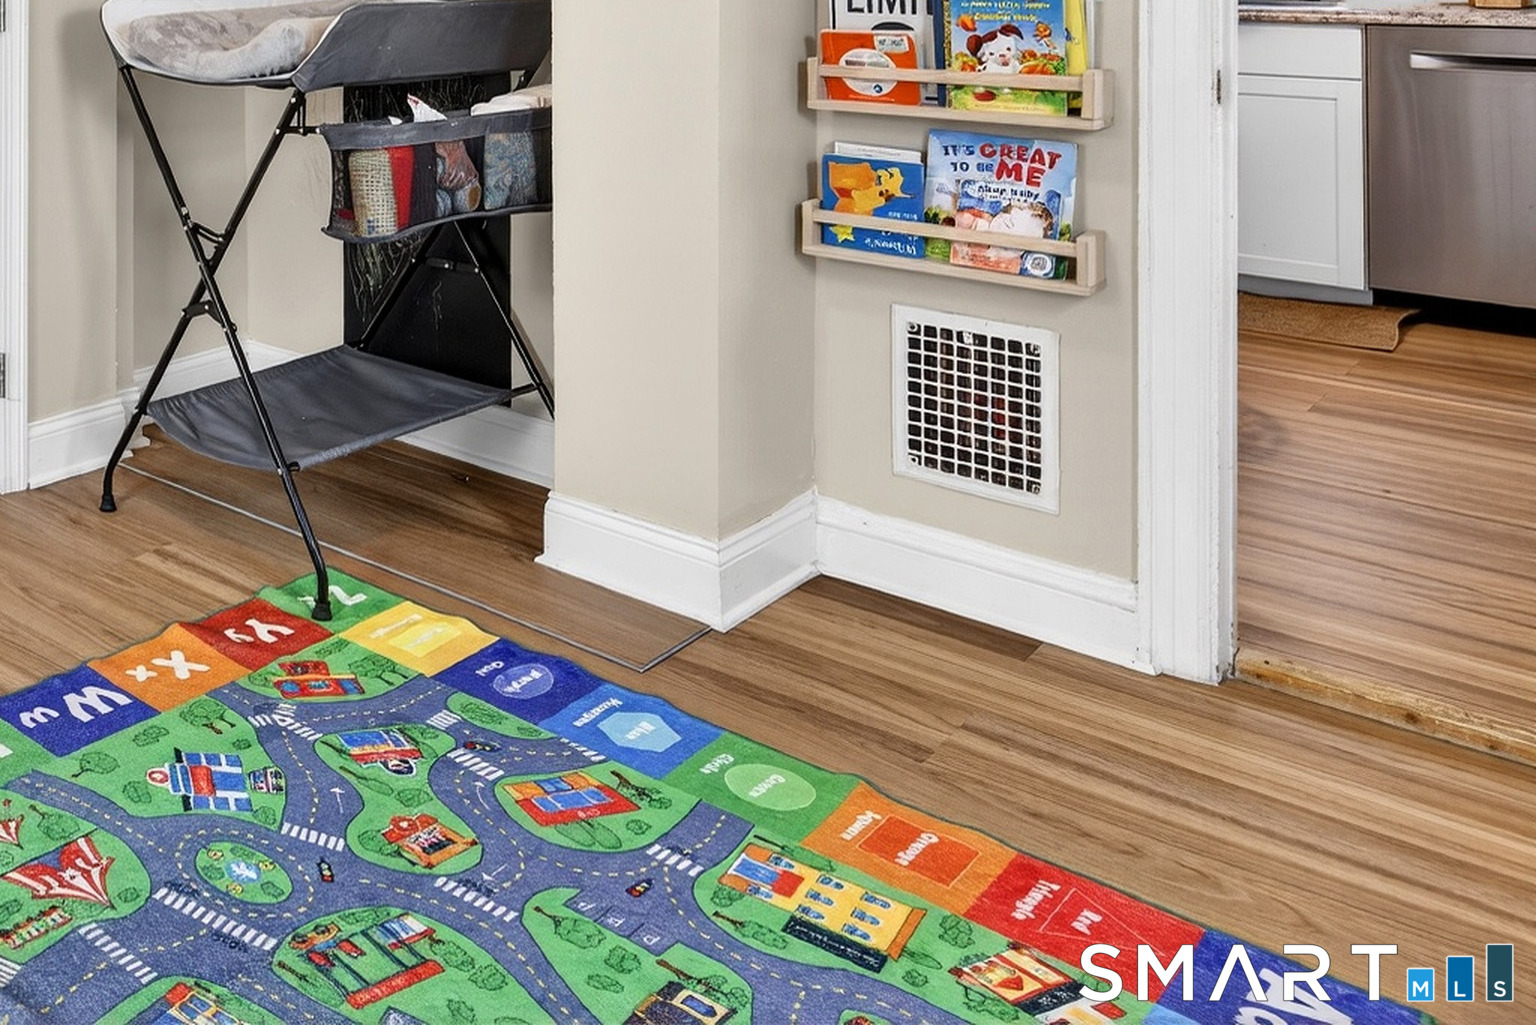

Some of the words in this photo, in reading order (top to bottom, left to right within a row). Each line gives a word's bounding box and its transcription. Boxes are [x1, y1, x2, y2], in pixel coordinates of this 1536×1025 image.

[979, 142, 1063, 170] GREAT
[950, 162, 970, 173] TO
[995, 159, 1047, 188] ME
[894, 830, 940, 867] Orange
[1010, 879, 1061, 920] Triangle
[1070, 908, 1103, 936] Red
